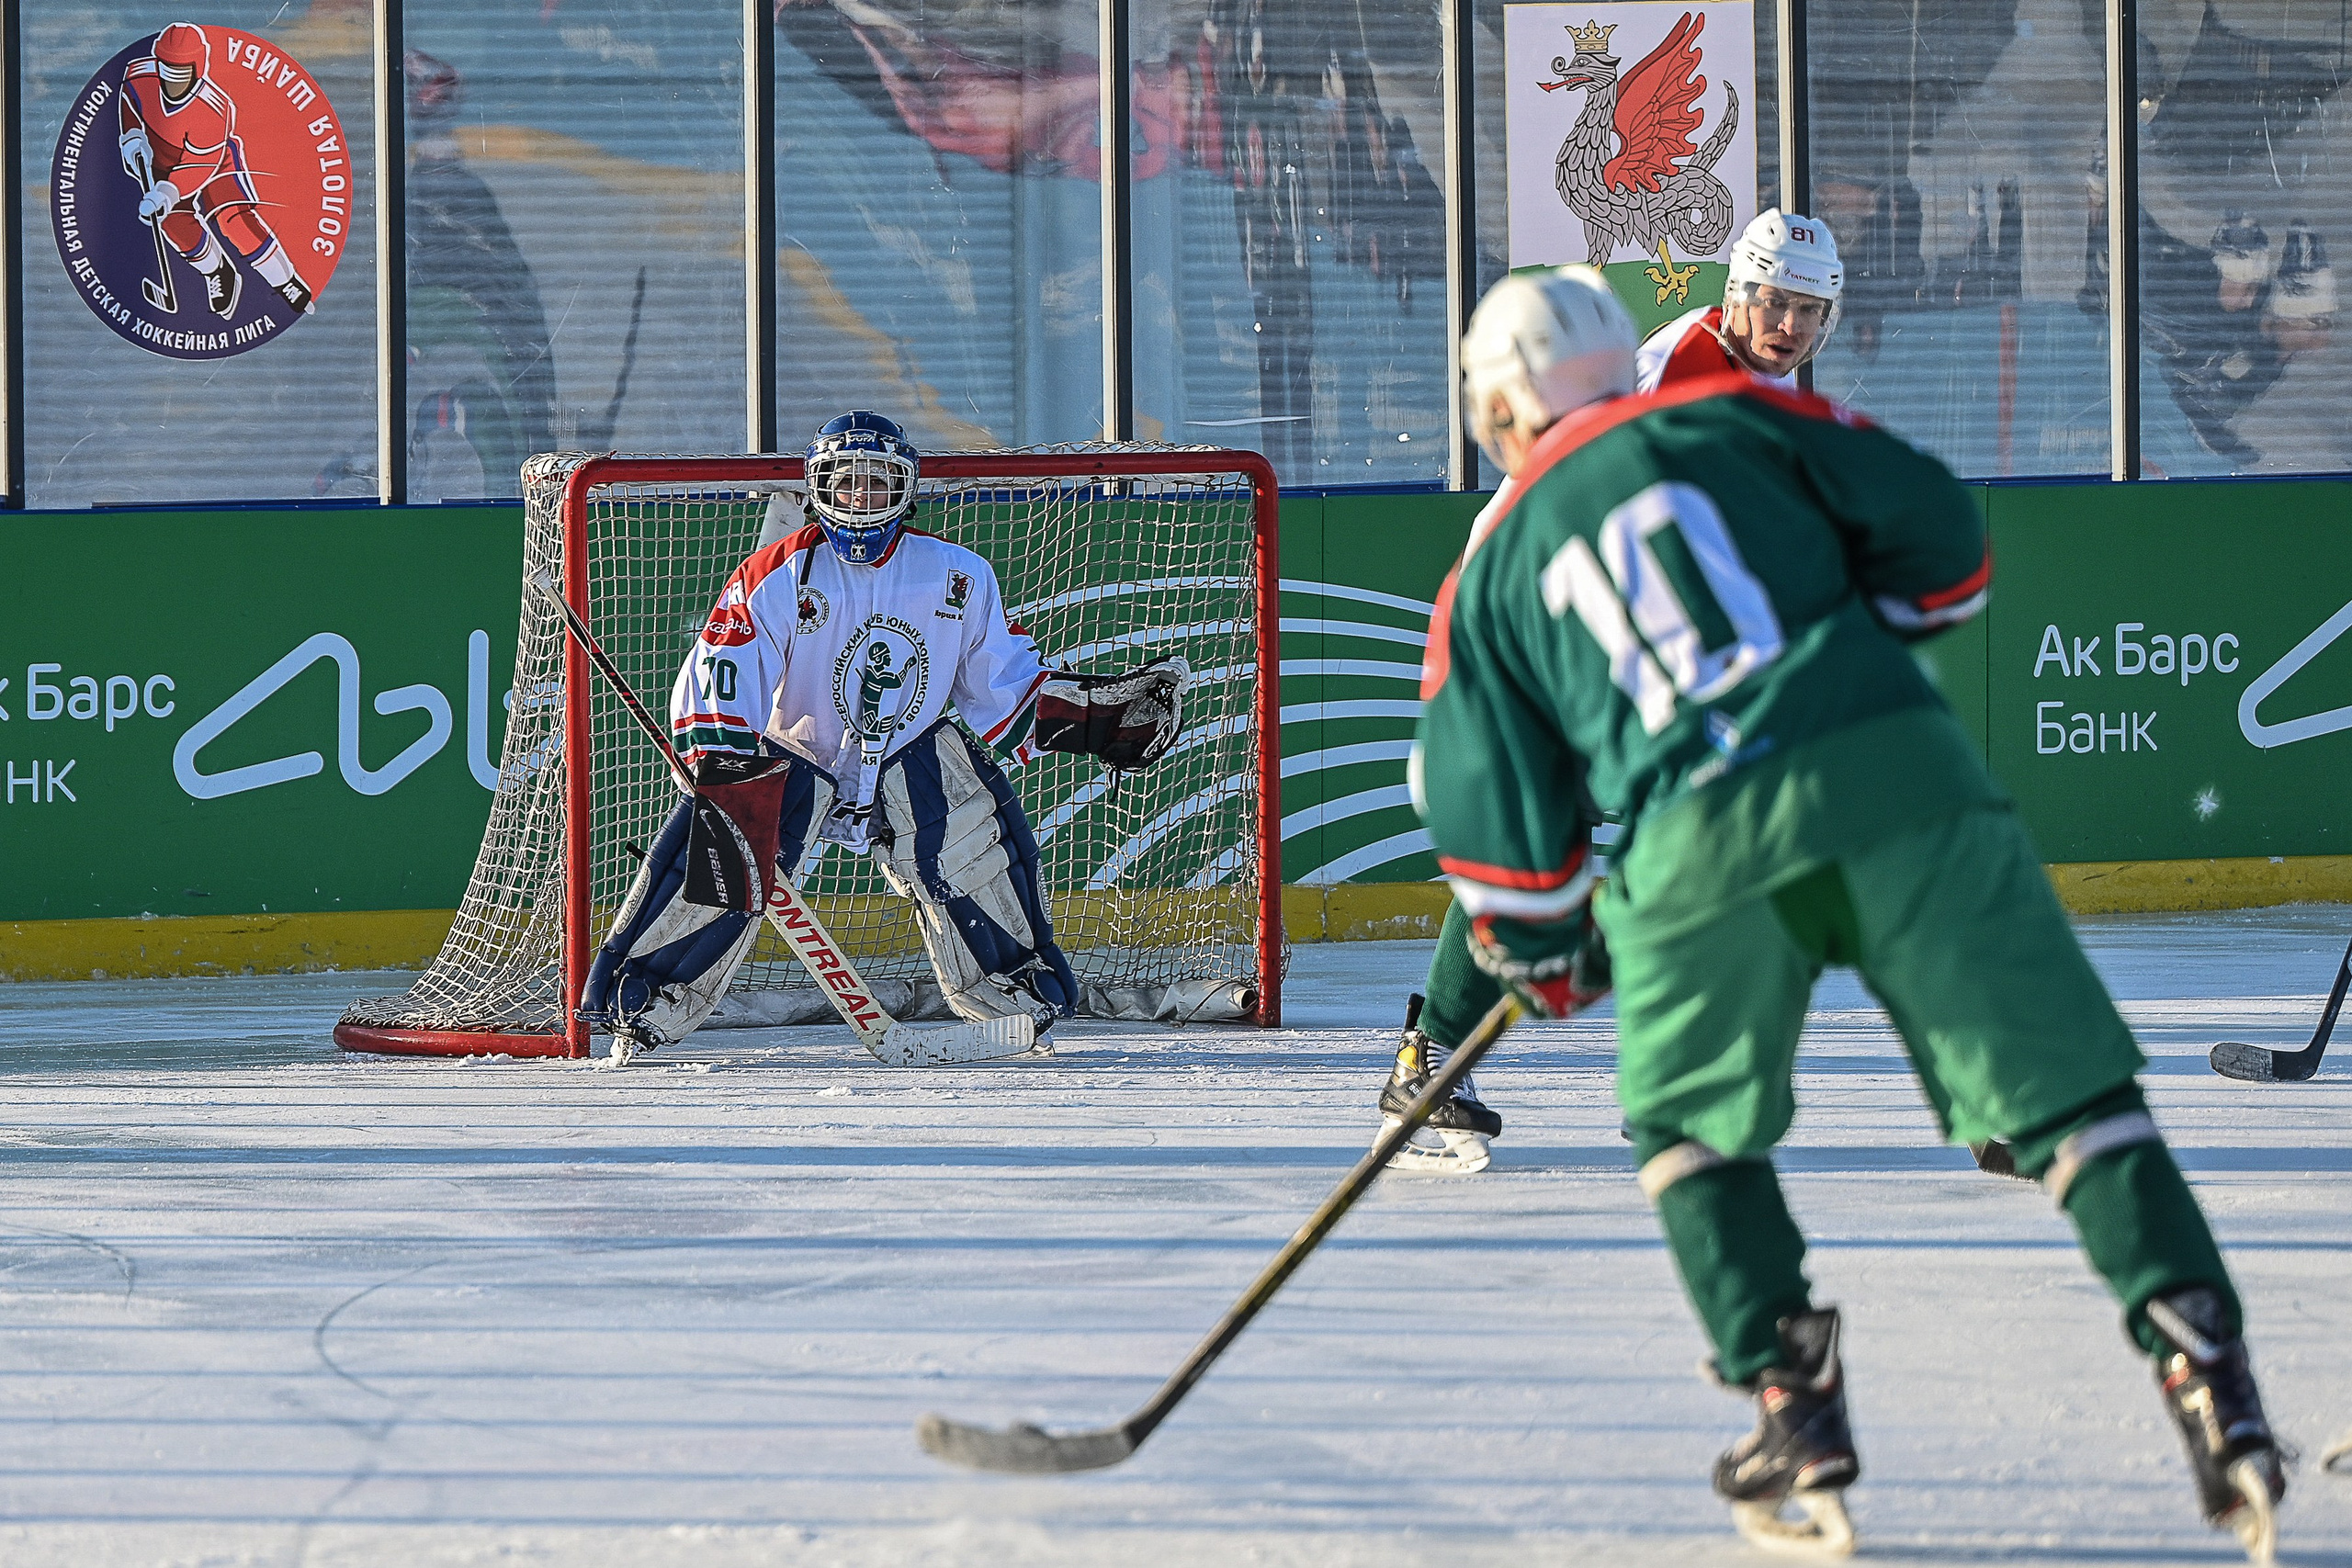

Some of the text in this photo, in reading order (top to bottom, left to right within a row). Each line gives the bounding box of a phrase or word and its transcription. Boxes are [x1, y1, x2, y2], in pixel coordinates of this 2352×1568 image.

[228, 37, 346, 257] ЗОЛОТАЯ ШАЙБА
[60, 81, 277, 352] КОНТИНЕНТАЛЬНАЯ ДЕТСКАЯ ХОККЕЙНАЯ ЛИГА
[1791, 227, 1815, 245] 81
[1791, 274, 1820, 284] TATNEFT
[1541, 481, 1784, 736] 10
[886, 615, 922, 641] ЮНЫХ
[905, 637, 930, 723] ХОККЕИСТОВ
[2033, 623, 2240, 686] Ак Барс
[27, 663, 175, 732] Барс
[2036, 701, 2158, 754] Банк
[707, 847, 729, 904] BAUER
[766, 878, 881, 1032] ONTREAL
